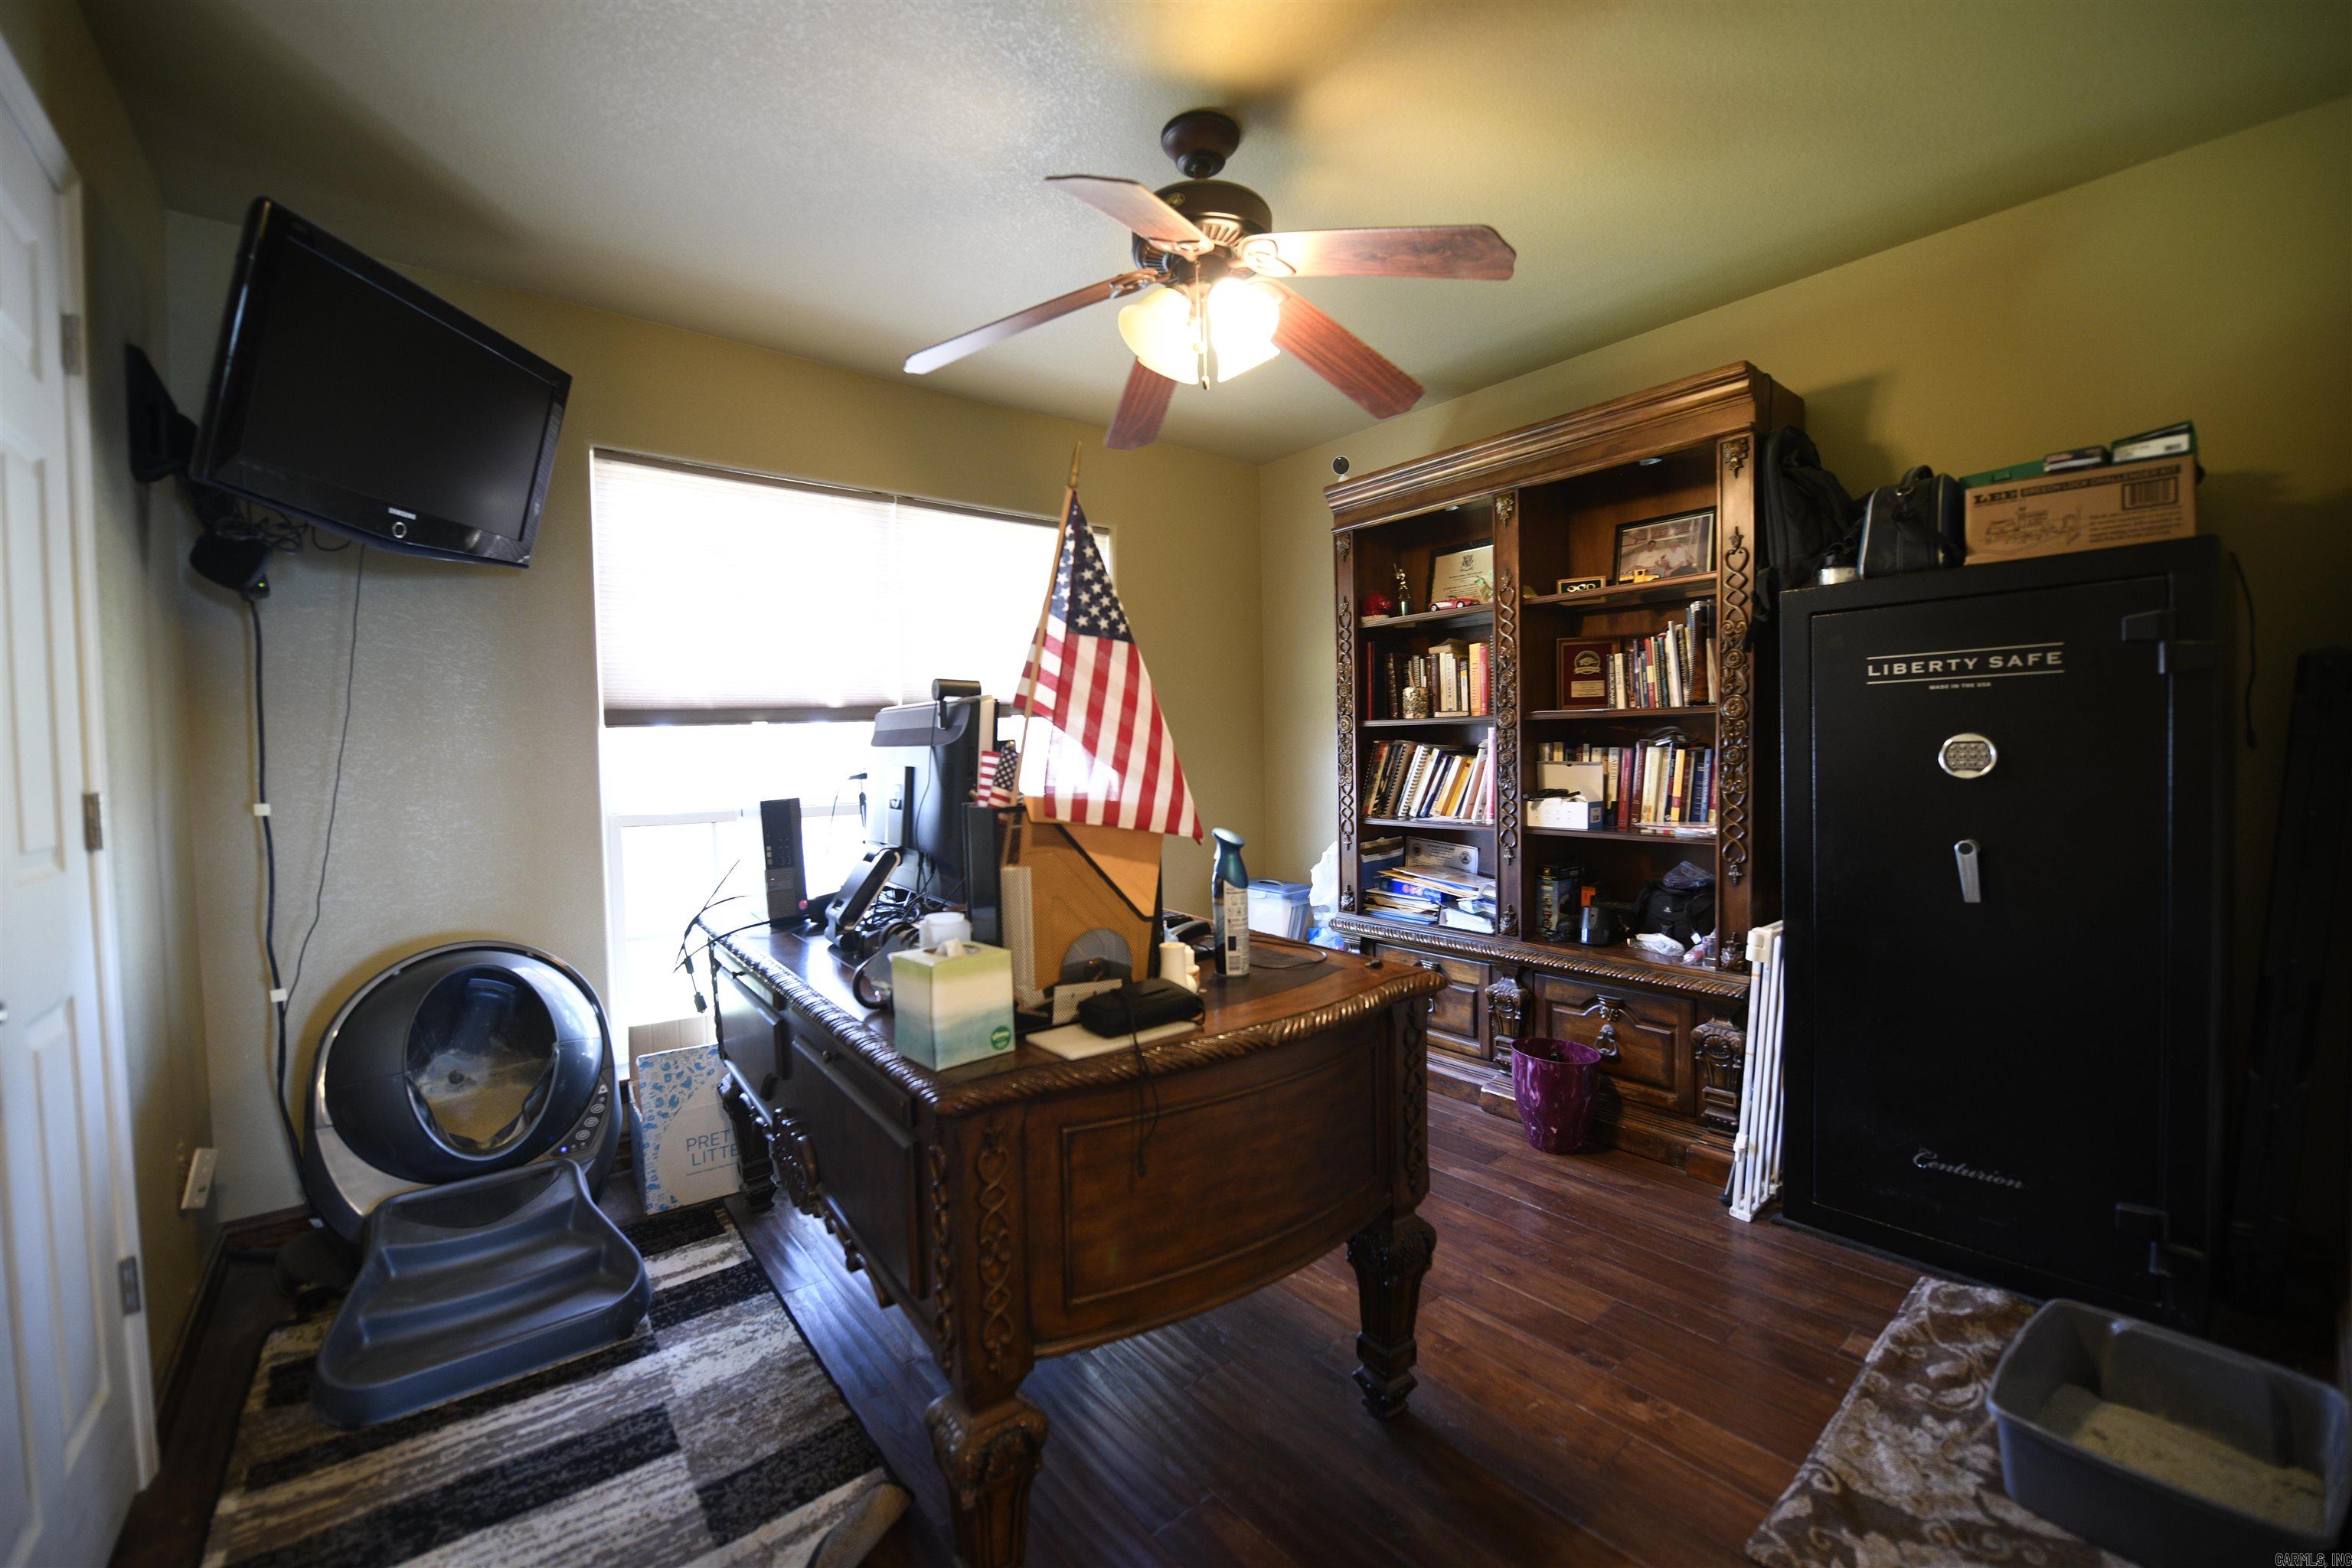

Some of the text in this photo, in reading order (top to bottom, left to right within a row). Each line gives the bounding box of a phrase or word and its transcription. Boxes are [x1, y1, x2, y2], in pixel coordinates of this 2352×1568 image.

[1974, 489, 2017, 505] LEE
[1867, 651, 2063, 677] LIBERTY SAFE
[686, 1129, 732, 1152] PRET
[691, 1143, 741, 1166] LITTE
[1913, 1146, 2026, 1189] Centurion
